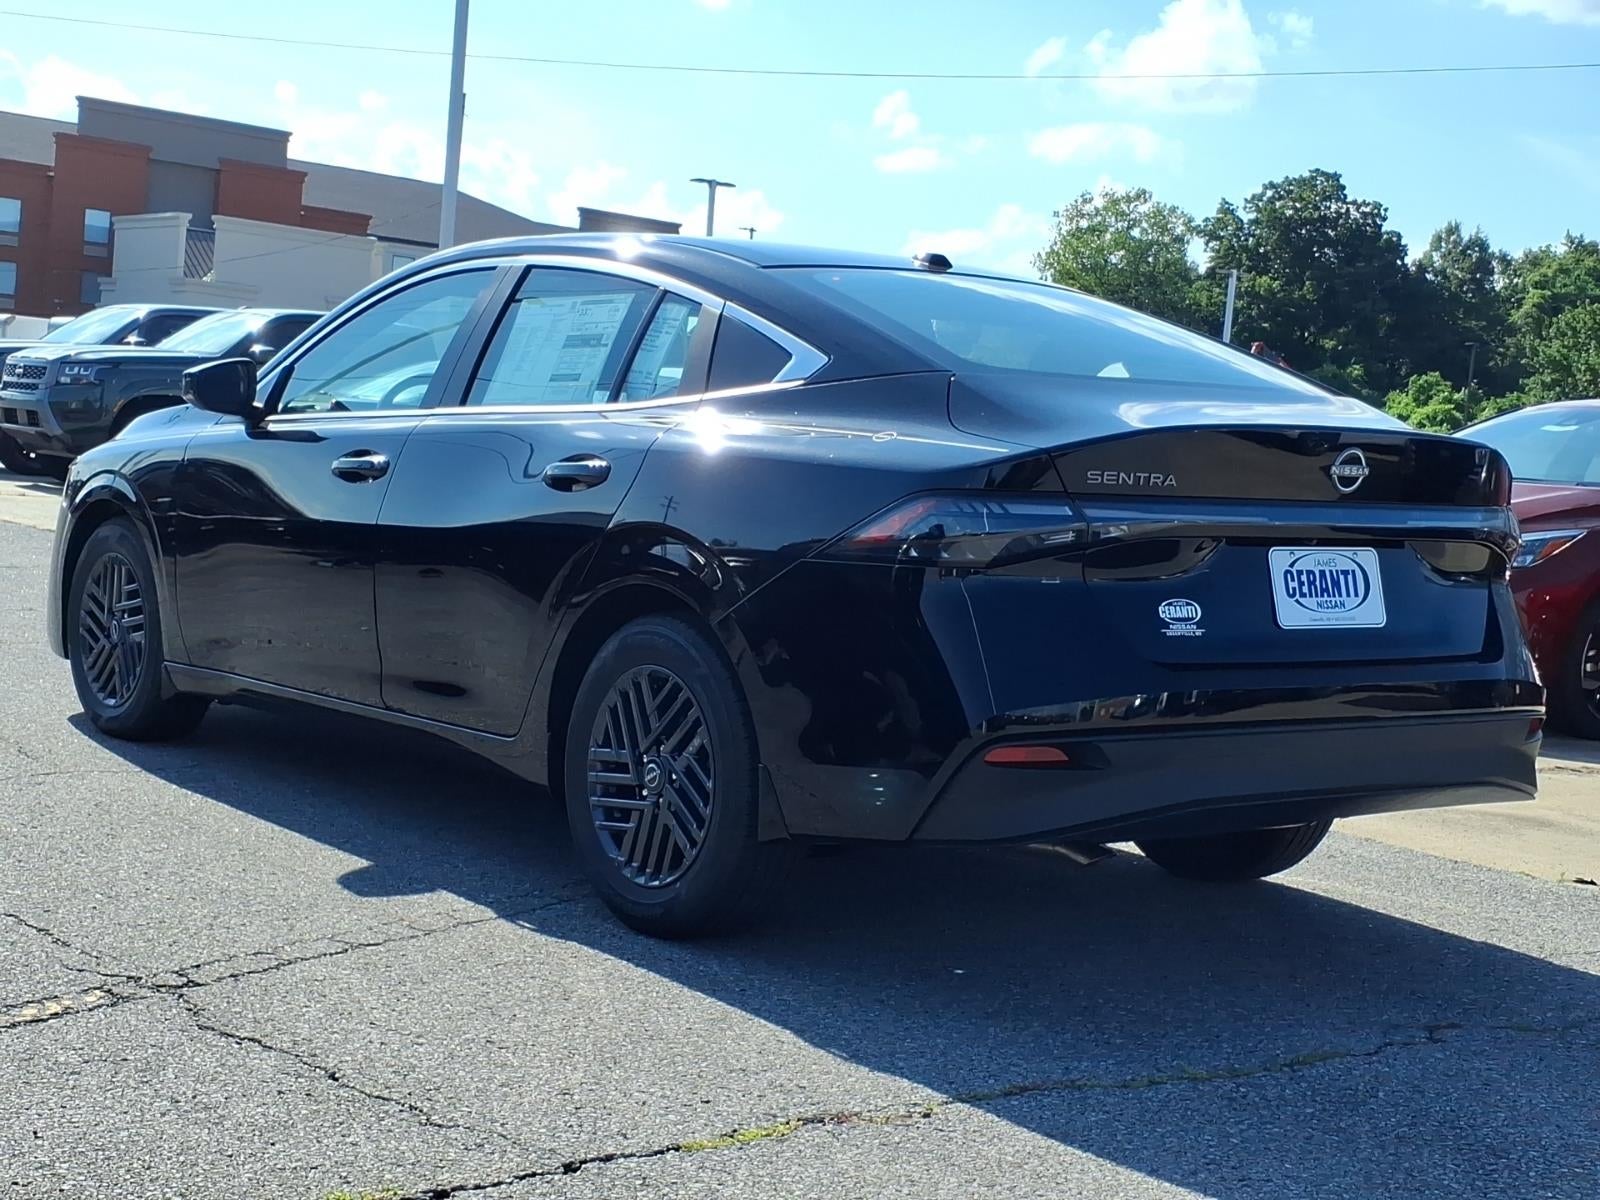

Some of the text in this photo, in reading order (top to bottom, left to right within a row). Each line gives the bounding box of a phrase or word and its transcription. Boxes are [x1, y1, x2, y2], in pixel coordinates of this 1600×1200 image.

[1330, 465, 1369, 477] NISSAN
[1087, 470, 1177, 487] SENTRA
[1314, 559, 1337, 568] JAMES
[1283, 569, 1360, 600] CERANTI
[1316, 600, 1346, 610] NISSAN
[1159, 606, 1196, 618] CERANTI
